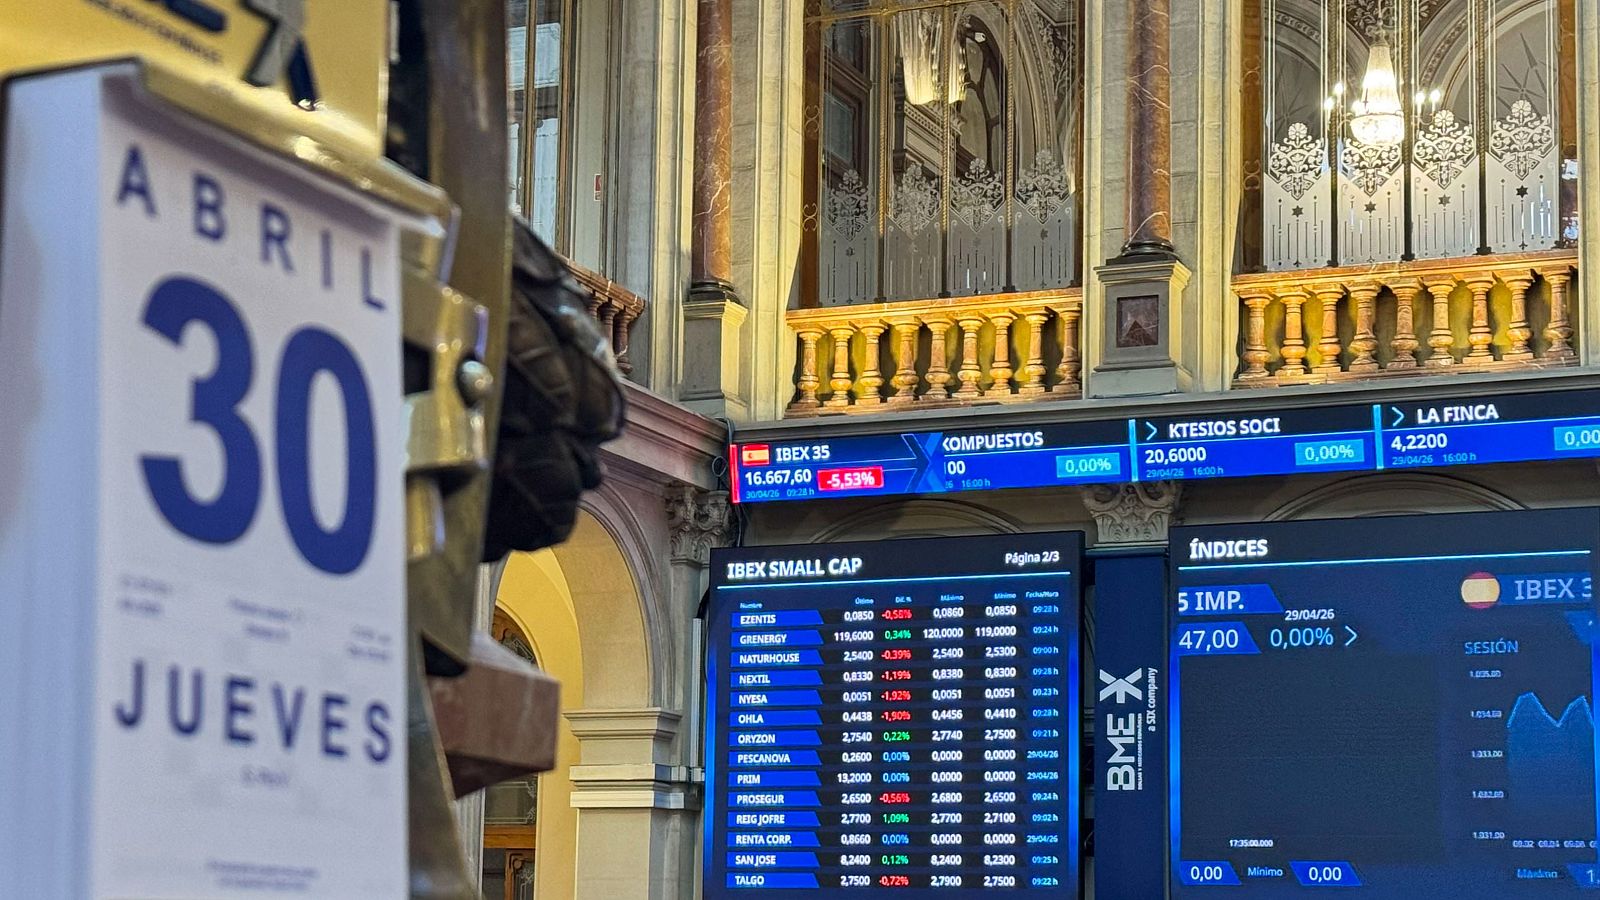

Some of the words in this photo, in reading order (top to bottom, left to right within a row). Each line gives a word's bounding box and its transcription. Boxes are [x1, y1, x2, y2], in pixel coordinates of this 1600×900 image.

[116, 144, 387, 313] ABRIL
[1417, 408, 1440, 424] LA
[1443, 404, 1499, 422] FINCA
[140, 271, 378, 578] 30
[1169, 419, 1236, 438] KTESIOS
[1240, 417, 1281, 434] SOCI
[1391, 433, 1448, 451] 4,2200
[776, 447, 810, 462] IBEX
[812, 445, 830, 459] 35
[1144, 446, 1206, 465] 20,6000
[1304, 444, 1354, 462] 0,00%
[1392, 455, 1433, 465] 29/04/26
[1442, 453, 1467, 462] 16:00
[1469, 452, 1477, 461] h
[1065, 458, 1112, 474] 0,00%
[1146, 468, 1184, 478] 29/04/26
[1193, 467, 1216, 476] 16:00
[1217, 466, 1224, 475] h
[745, 468, 812, 485] 16.667,60
[826, 471, 875, 488] -5,53%
[961, 479, 984, 488] 16:00
[985, 478, 991, 487] h
[746, 490, 780, 499] 30/04/26
[1189, 537, 1268, 560] ÍNDICES
[1005, 552, 1041, 566] Página
[1042, 550, 1060, 562] 2/3
[727, 562, 767, 579] IBEX
[769, 559, 825, 577] SMALL
[828, 557, 863, 575] CAP
[1514, 578, 1575, 601] IBEX
[1178, 592, 1189, 612] 5
[1194, 590, 1245, 611] IMP.
[740, 615, 776, 625] EZENTIS
[844, 610, 874, 621] 0,0850
[881, 610, 912, 620] -0,58%
[933, 607, 964, 618] 0,0860
[985, 605, 1017, 617] 0,0850
[1053, 604, 1059, 614] h
[1284, 609, 1335, 621] 29/04/26
[740, 634, 787, 645] GRENERGY
[834, 630, 874, 642] 119,6000
[884, 629, 911, 640] 0,34%
[922, 627, 964, 639] 120,0000
[975, 625, 1017, 637] 119,0000
[1053, 625, 1059, 634] h
[1178, 629, 1239, 652] 47,00
[1269, 627, 1335, 650] 0,00%
[739, 653, 800, 664] NATURHOUSE
[843, 650, 874, 662] 2,5400
[881, 650, 912, 660] -0,39%
[932, 648, 963, 659] 2,5400
[985, 646, 1017, 658] 2,5300
[1053, 645, 1059, 655] h
[1464, 637, 1519, 655] SESIÓN
[739, 674, 771, 684] NEXTIL
[843, 671, 873, 683] 0,8330
[881, 671, 911, 681] -1,19%
[932, 669, 963, 680] 0,8380
[985, 667, 1016, 679] 0,8300
[1053, 666, 1059, 676] h
[738, 694, 768, 704] NYESA
[843, 691, 872, 703] 0,0051
[881, 691, 911, 701] -1,92%
[932, 689, 962, 701] 0,0051
[985, 688, 1015, 699] 0,0051
[1053, 687, 1059, 697] h
[1147, 667, 1158, 708] company
[113, 656, 392, 765] JUEVES
[738, 714, 764, 724] OHLA
[842, 711, 873, 723] 0,4438
[881, 711, 911, 721] -1,90%
[931, 709, 963, 721] 0,4456
[984, 708, 1016, 720] 0,4410
[1053, 708, 1059, 718] h
[1146, 708, 1156, 724] SIX
[737, 734, 776, 744] ORYZON
[842, 732, 872, 743] 2,7540
[883, 731, 910, 742] 0,22%
[931, 730, 963, 742] 2,7740
[984, 729, 1016, 740] 2,7500
[1053, 729, 1059, 738] h
[737, 754, 791, 764] PESCANOVA
[842, 751, 872, 763] 0,2600
[883, 751, 910, 762] 0,00%
[931, 750, 963, 762] 0,0000
[984, 750, 1016, 761] 0,0000
[1106, 713, 1135, 791] BME
[737, 774, 761, 785] PRIM
[837, 773, 872, 784] 13,2000
[882, 772, 910, 783] 0,00%
[931, 771, 963, 783] 0,0000
[984, 770, 1016, 782] 0,0000
[736, 794, 785, 805] PROSEGUR
[841, 793, 872, 804] 2,6500
[879, 793, 910, 804] -0,56%
[931, 792, 963, 804] 2,6800
[984, 792, 1016, 803] 2,6500
[1053, 792, 1059, 801] h
[736, 814, 757, 825] REIG
[757, 814, 785, 826] JOFRE
[841, 813, 871, 825] 2,7700
[882, 813, 910, 824] 1,09%
[931, 812, 962, 824] 2,7700
[984, 812, 1016, 824] 2,7100
[1053, 812, 1059, 822] h
[736, 834, 765, 845] RENTA
[766, 834, 792, 845] CORP.
[841, 833, 871, 845] 0,8660
[882, 834, 909, 845] 0,00%
[931, 833, 962, 845] 0,0000
[984, 833, 1016, 845] 0,0000
[735, 855, 754, 865] SAN
[754, 855, 777, 867] JOSE
[840, 855, 871, 866] 8,2400
[881, 855, 909, 866] 0,12%
[930, 854, 962, 866] 8,2400
[983, 854, 1016, 866] 8,2300
[1053, 855, 1059, 864] h
[735, 875, 765, 885] TALGO
[840, 875, 871, 887] 2,7500
[879, 876, 909, 887] -0,72%
[930, 875, 962, 887] 2,7900
[983, 875, 1016, 887] 2,7500
[1053, 876, 1059, 886] h
[1190, 866, 1223, 882] 0,00
[1247, 866, 1283, 877] Mínimo
[1308, 866, 1342, 883] 0,00
